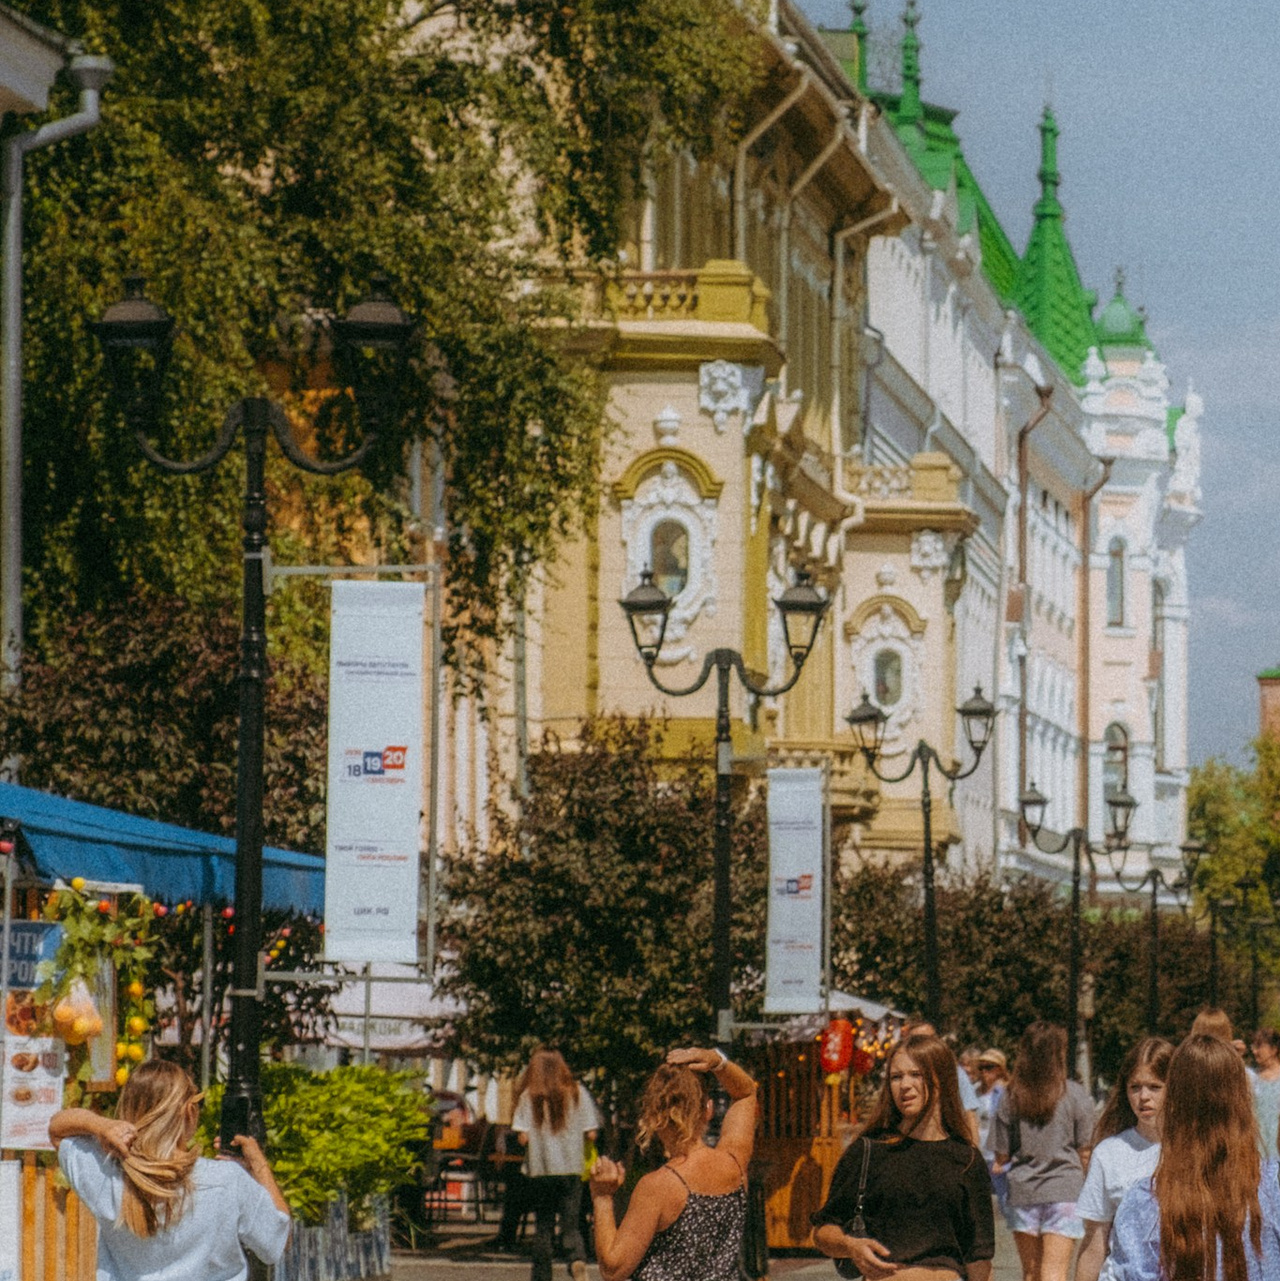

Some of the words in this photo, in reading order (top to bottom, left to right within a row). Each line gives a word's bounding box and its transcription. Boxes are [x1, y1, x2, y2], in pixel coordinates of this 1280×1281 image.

[346, 764, 362, 777] 18
[364, 756, 381, 771] 19
[385, 750, 404, 766] 20
